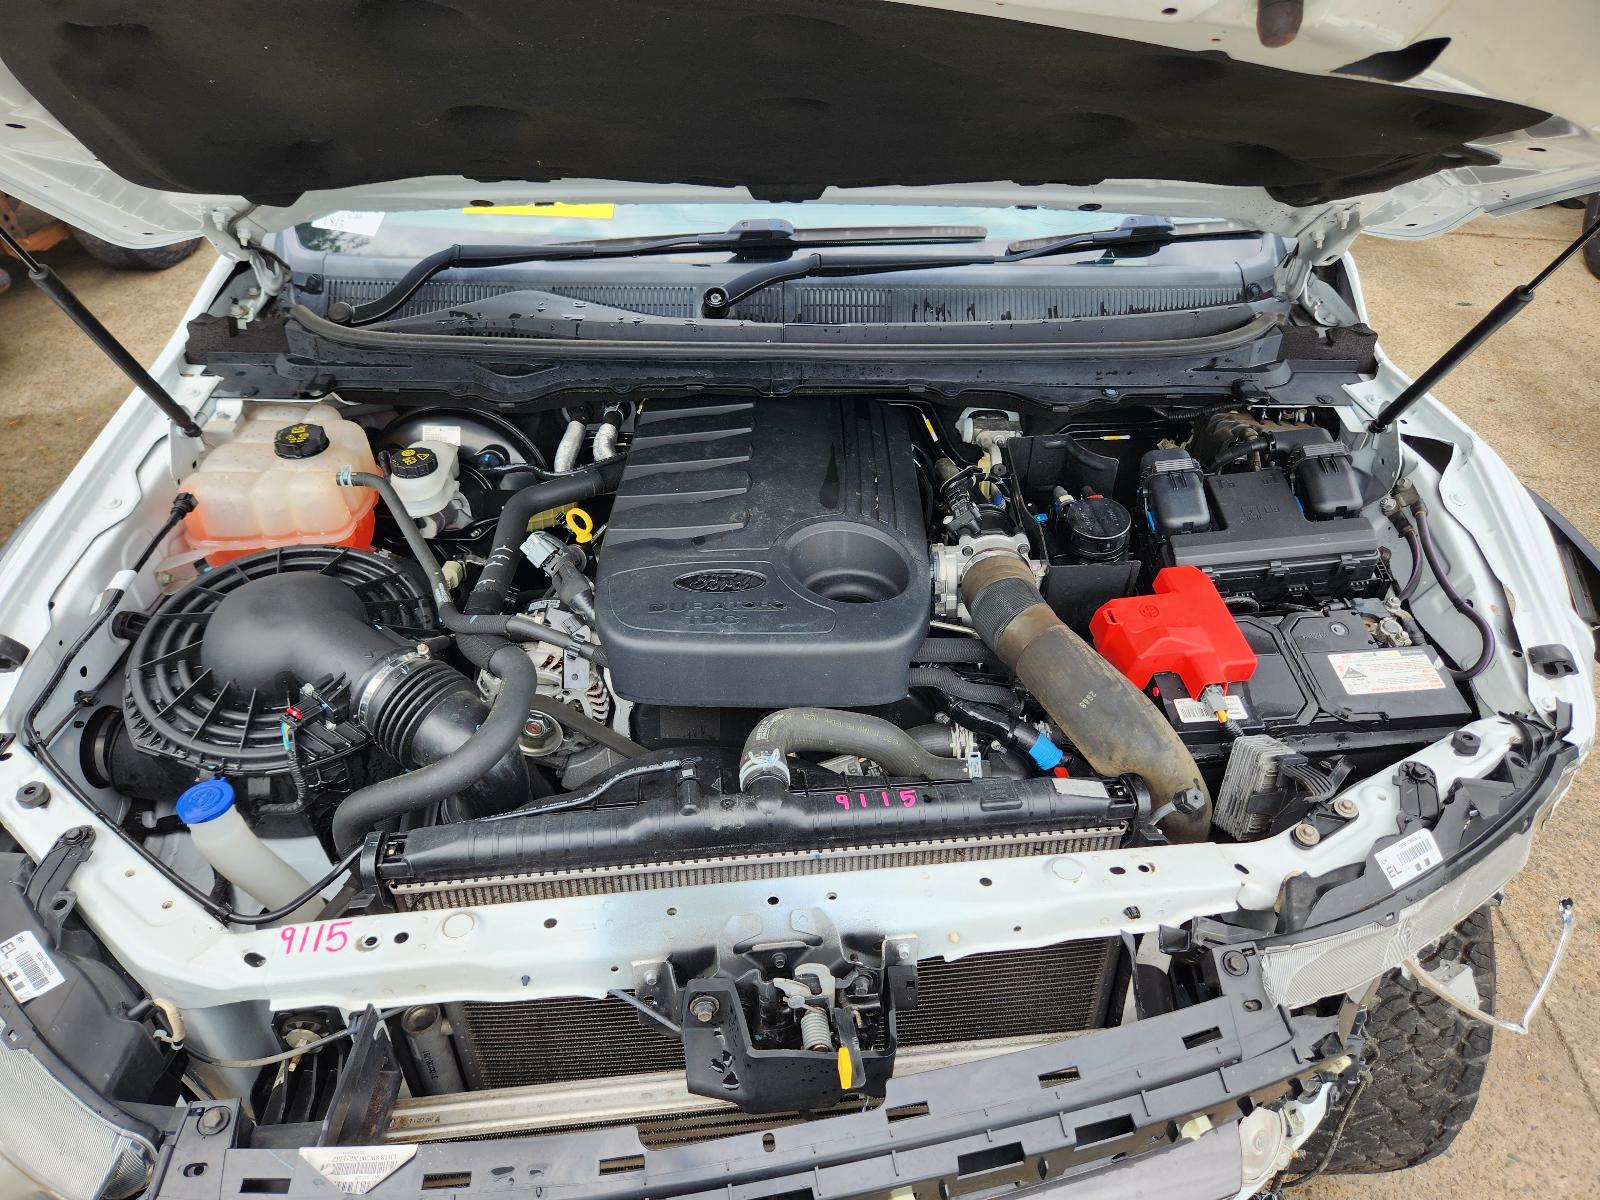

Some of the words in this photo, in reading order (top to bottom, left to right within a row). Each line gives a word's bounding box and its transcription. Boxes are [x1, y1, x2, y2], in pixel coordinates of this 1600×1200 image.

[688, 571, 756, 592] Ford
[835, 788, 917, 811] 9115
[1386, 864, 1402, 879] EL
[280, 920, 353, 955] 9115
[0, 941, 17, 960] EL
